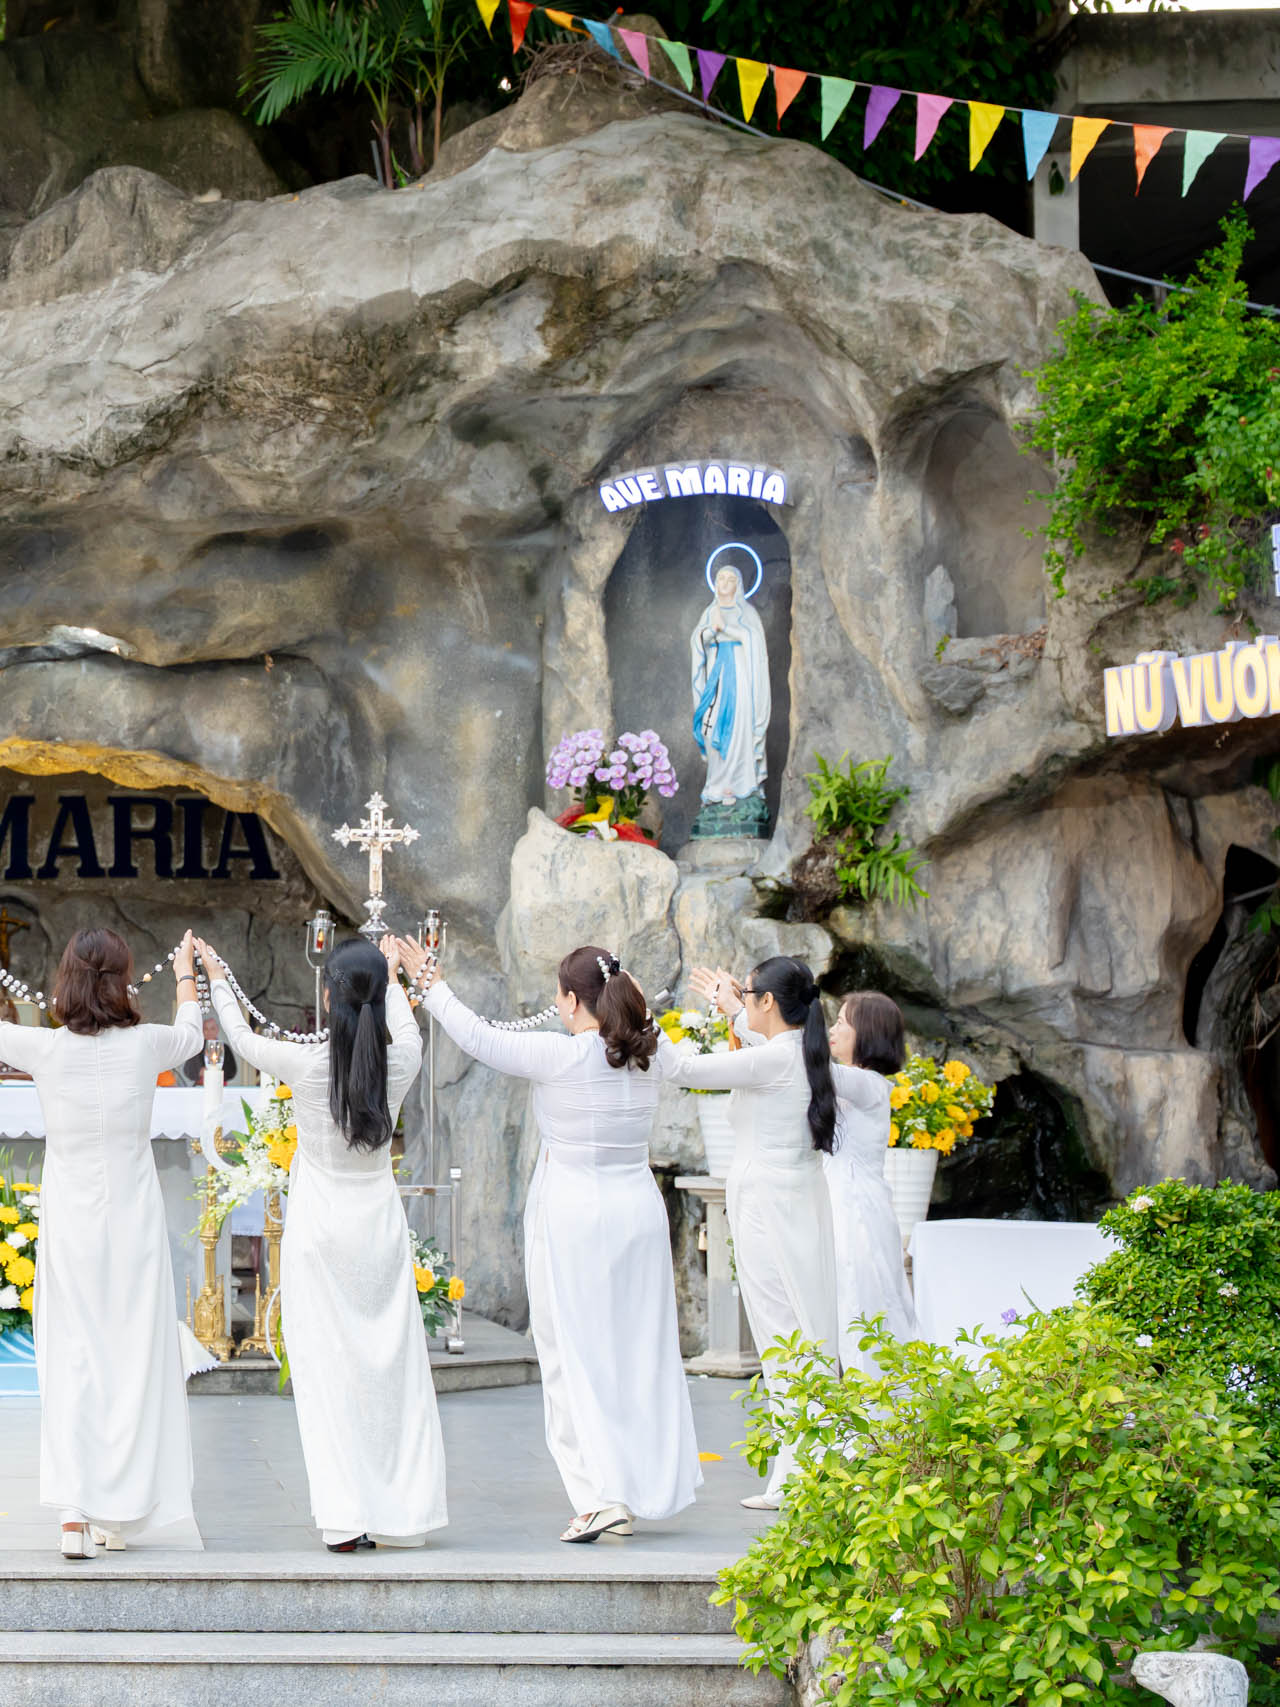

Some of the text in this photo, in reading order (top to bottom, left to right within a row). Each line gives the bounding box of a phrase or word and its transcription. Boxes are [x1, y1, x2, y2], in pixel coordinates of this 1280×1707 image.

[600, 464, 785, 513] AVE MARIA
[1104, 651, 1170, 737] NỮ
